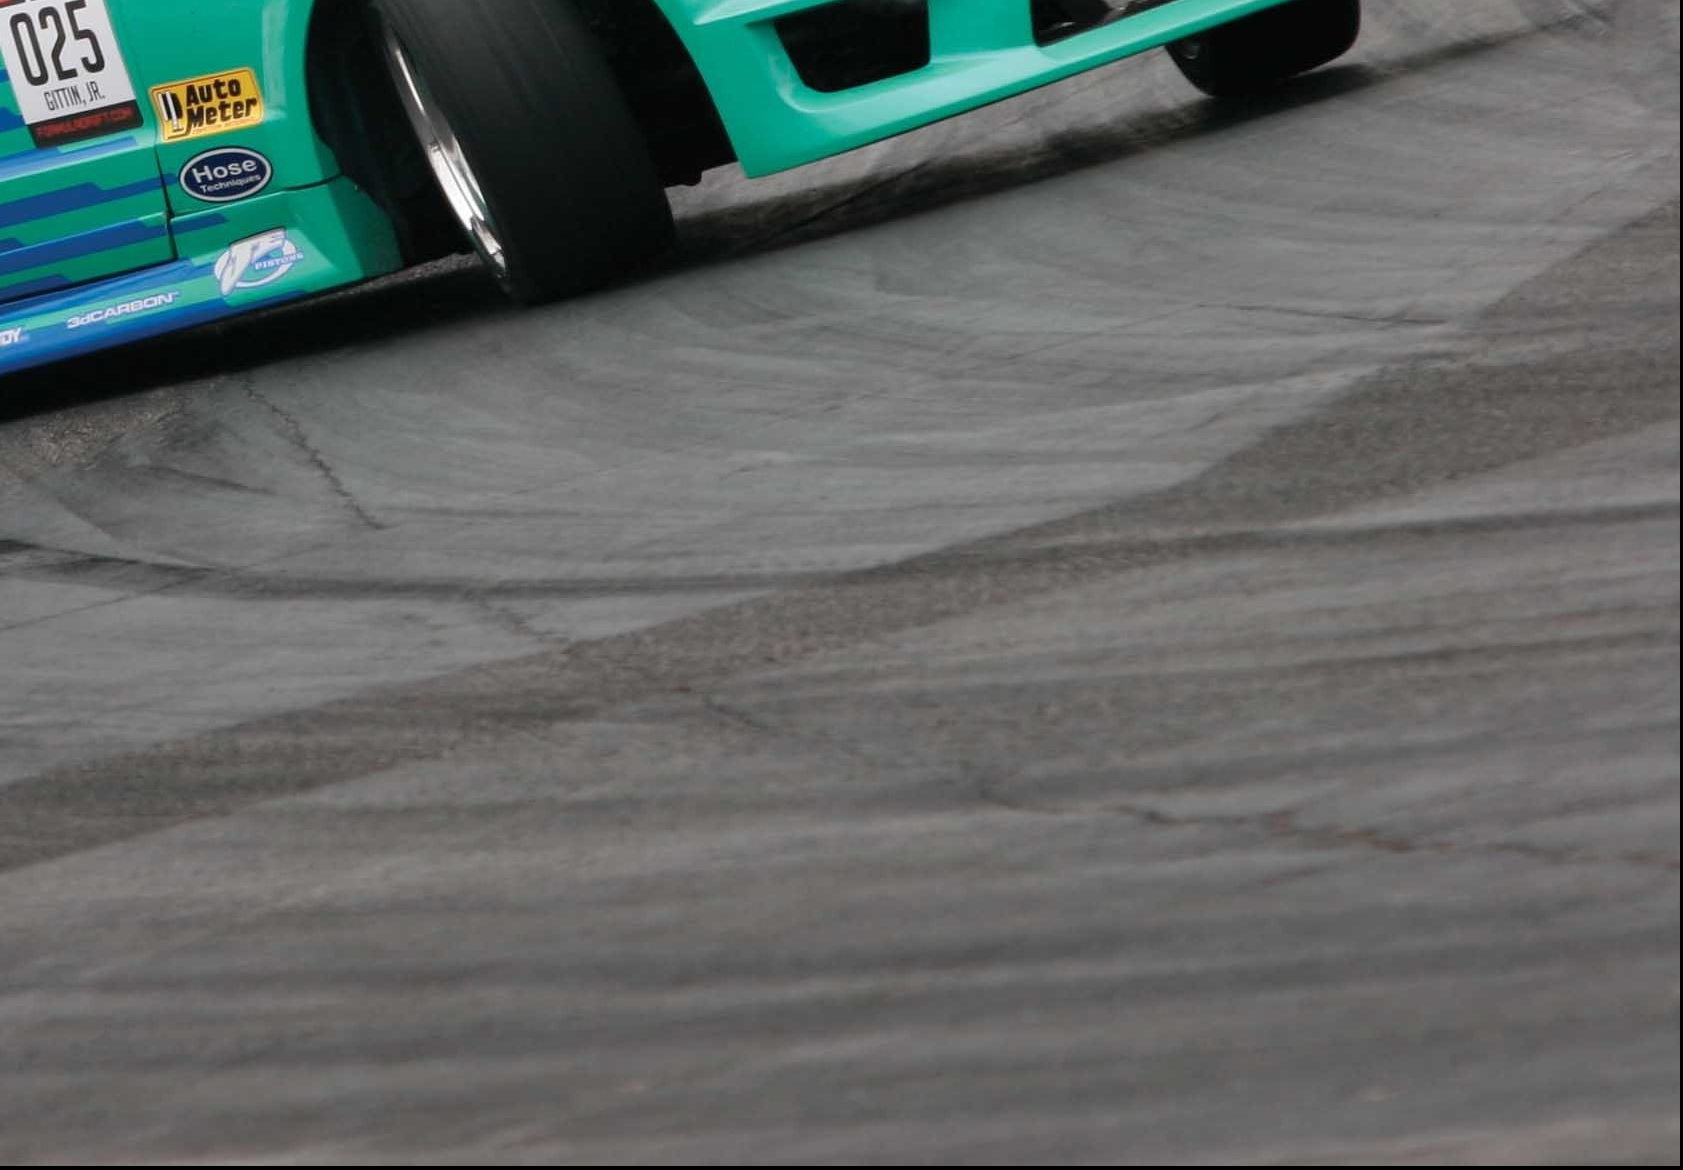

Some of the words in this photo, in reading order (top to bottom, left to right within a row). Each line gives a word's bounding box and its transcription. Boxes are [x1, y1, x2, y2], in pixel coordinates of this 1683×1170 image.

[43, 84, 87, 112] GITTIN,
[86, 80, 106, 103] JR.
[185, 78, 242, 107] Auto
[186, 96, 258, 129] Meter
[191, 159, 258, 184] Hose
[199, 174, 262, 193] Techniques
[254, 251, 305, 271] PISTONS
